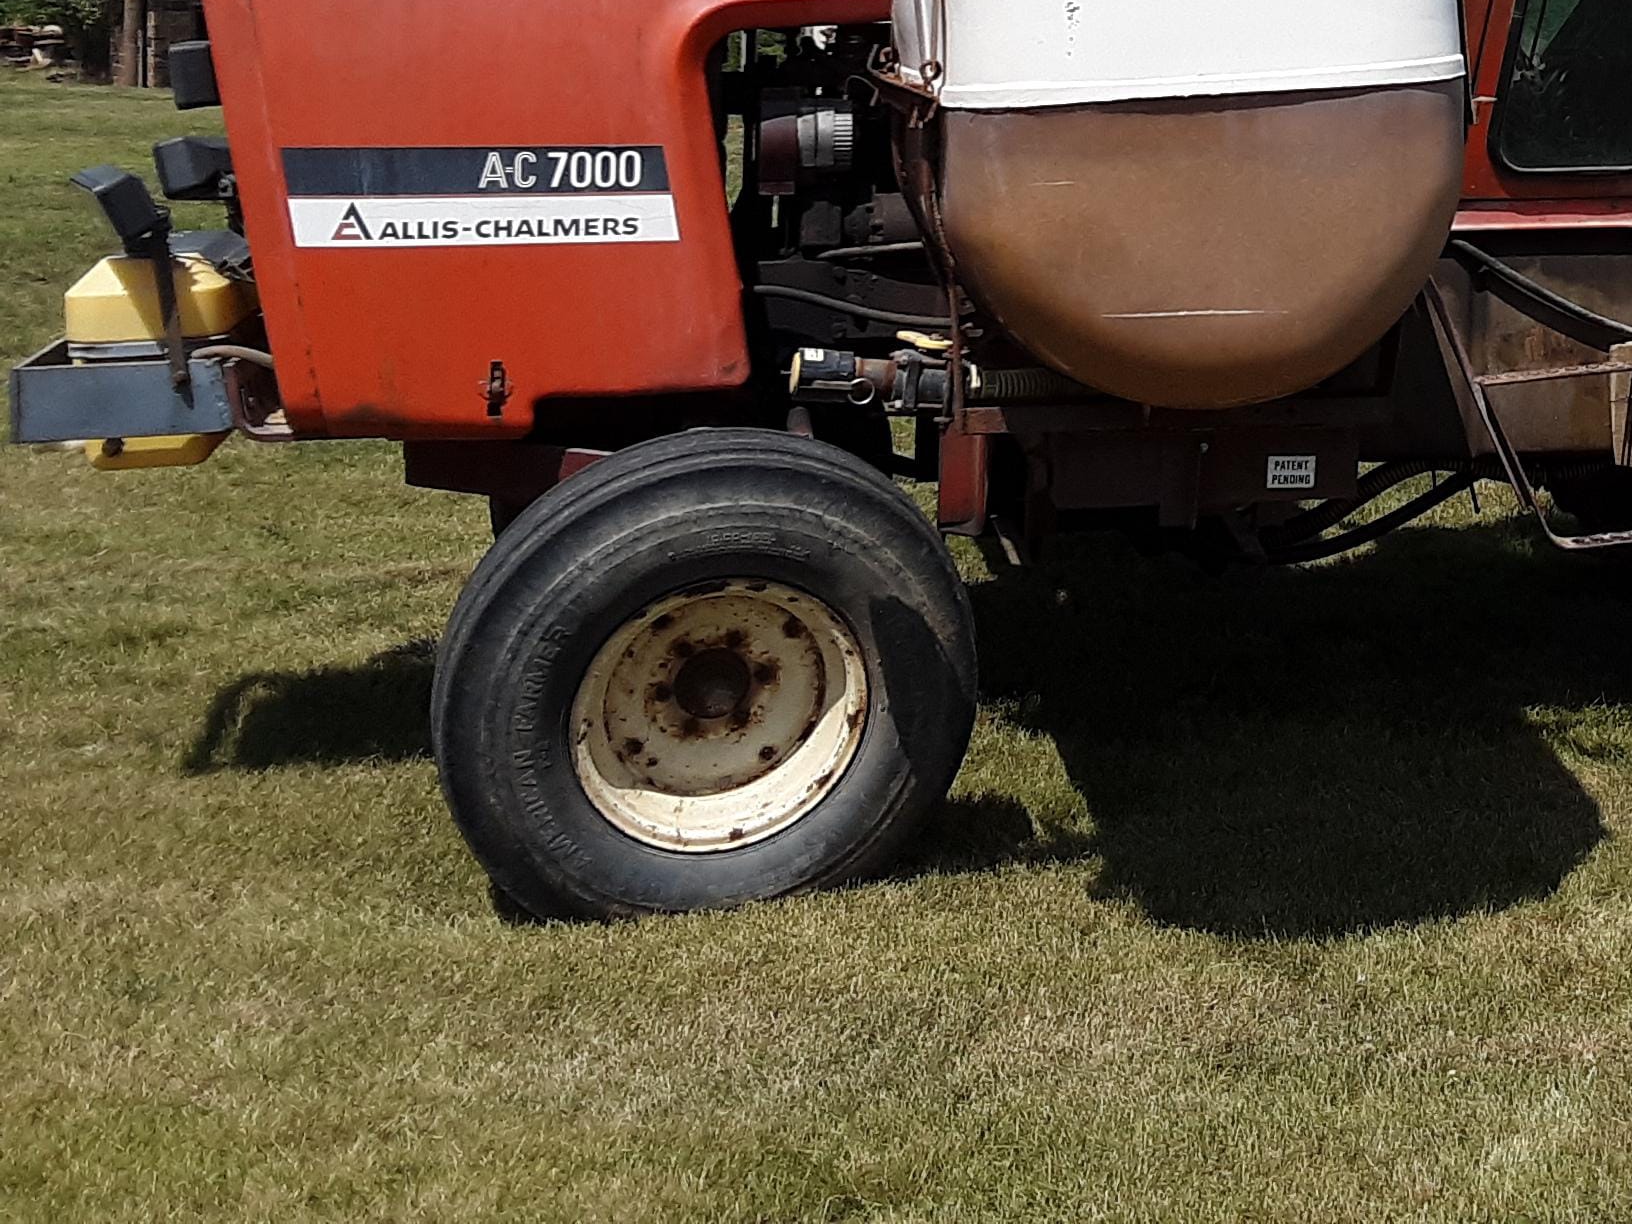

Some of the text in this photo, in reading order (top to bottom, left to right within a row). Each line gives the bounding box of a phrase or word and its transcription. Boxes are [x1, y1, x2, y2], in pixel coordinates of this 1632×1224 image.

[546, 150, 643, 188] 7000
[378, 216, 640, 241] ALLIS-CHALMERS
[1273, 459, 1310, 471] PATENT
[1271, 474, 1311, 485] PENDING
